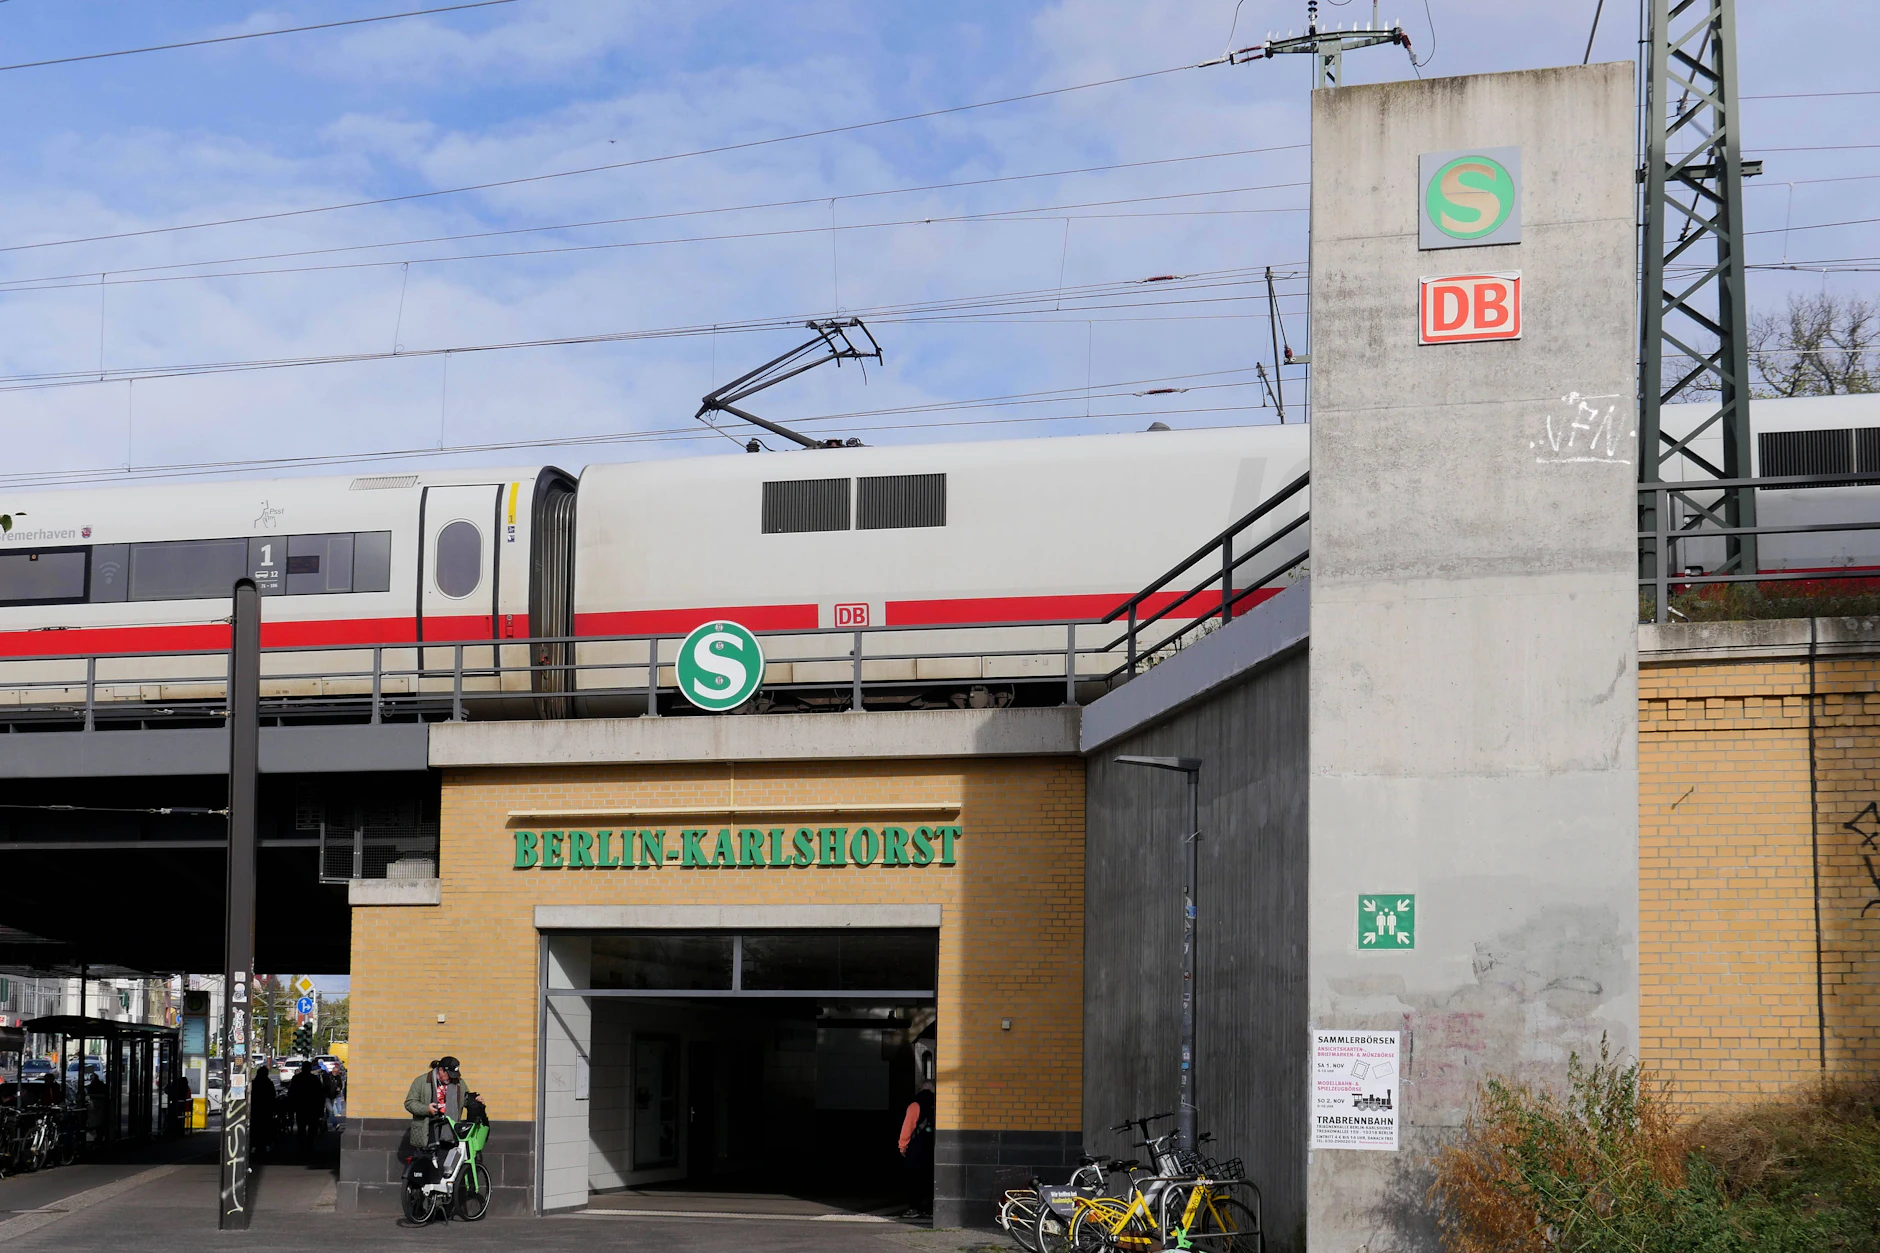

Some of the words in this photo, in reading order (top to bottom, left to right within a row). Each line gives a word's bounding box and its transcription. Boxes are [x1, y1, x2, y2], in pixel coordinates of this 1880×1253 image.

[1440, 163, 1501, 233] S
[1433, 282, 1509, 332] DB
[0, 528, 76, 541] remerhaven
[261, 544, 274, 567] 1
[839, 607, 866, 625] DB
[693, 632, 747, 699] S
[514, 825, 962, 869] BERLIN-KARLSHORST
[1318, 1035, 1395, 1045] SAMMLERBÖRSEN
[1317, 1116, 1394, 1125] TRABRENNBAHN
